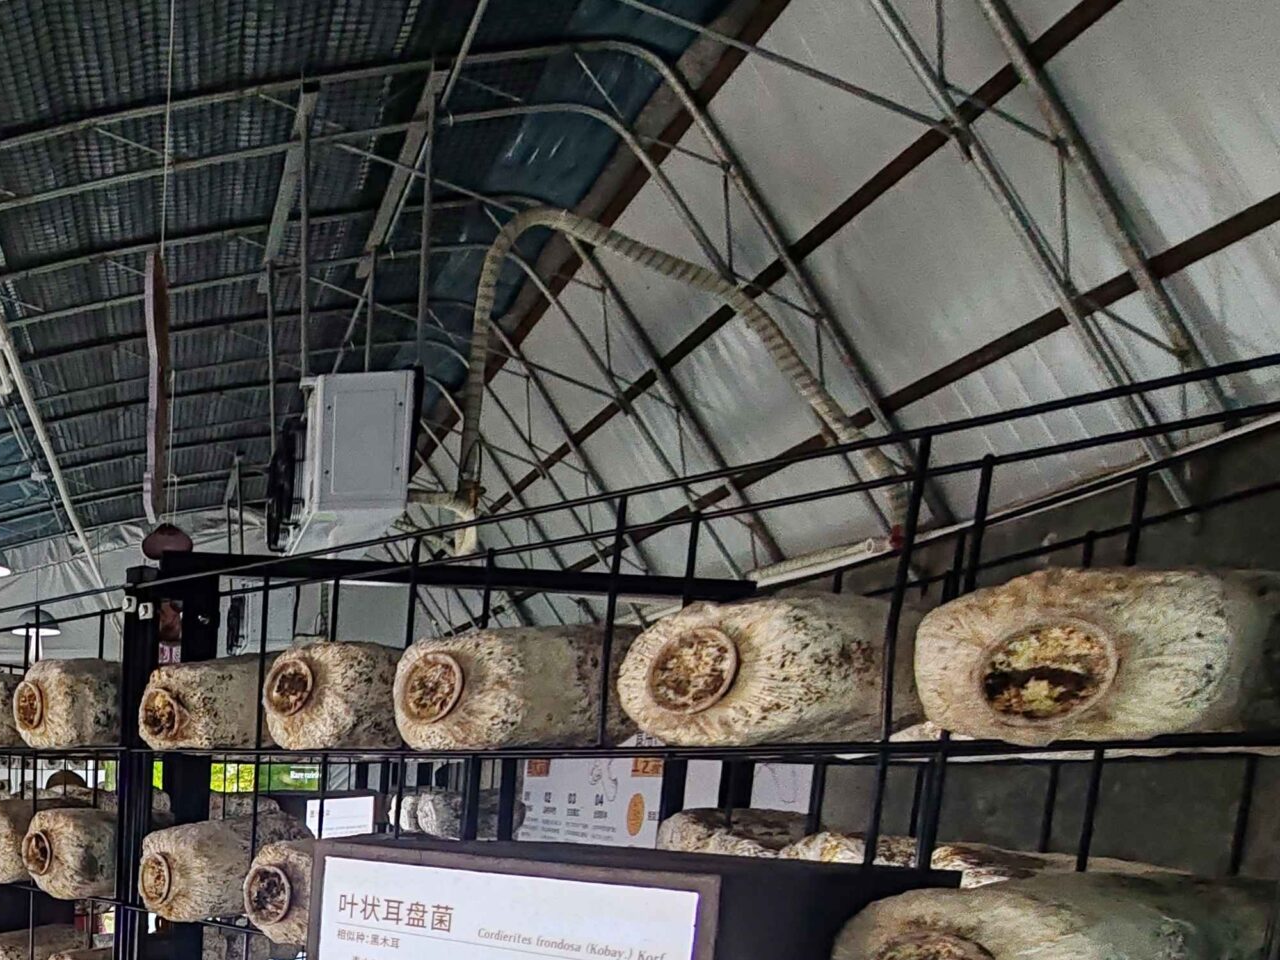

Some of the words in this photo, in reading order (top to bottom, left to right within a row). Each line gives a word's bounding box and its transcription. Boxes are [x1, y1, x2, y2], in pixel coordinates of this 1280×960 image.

[338, 893, 454, 933] 叶状耳盘菌
[477, 928, 532, 945] Cordierites
[536, 936, 582, 952] frondosa
[586, 943, 633, 960] (Kobay.)
